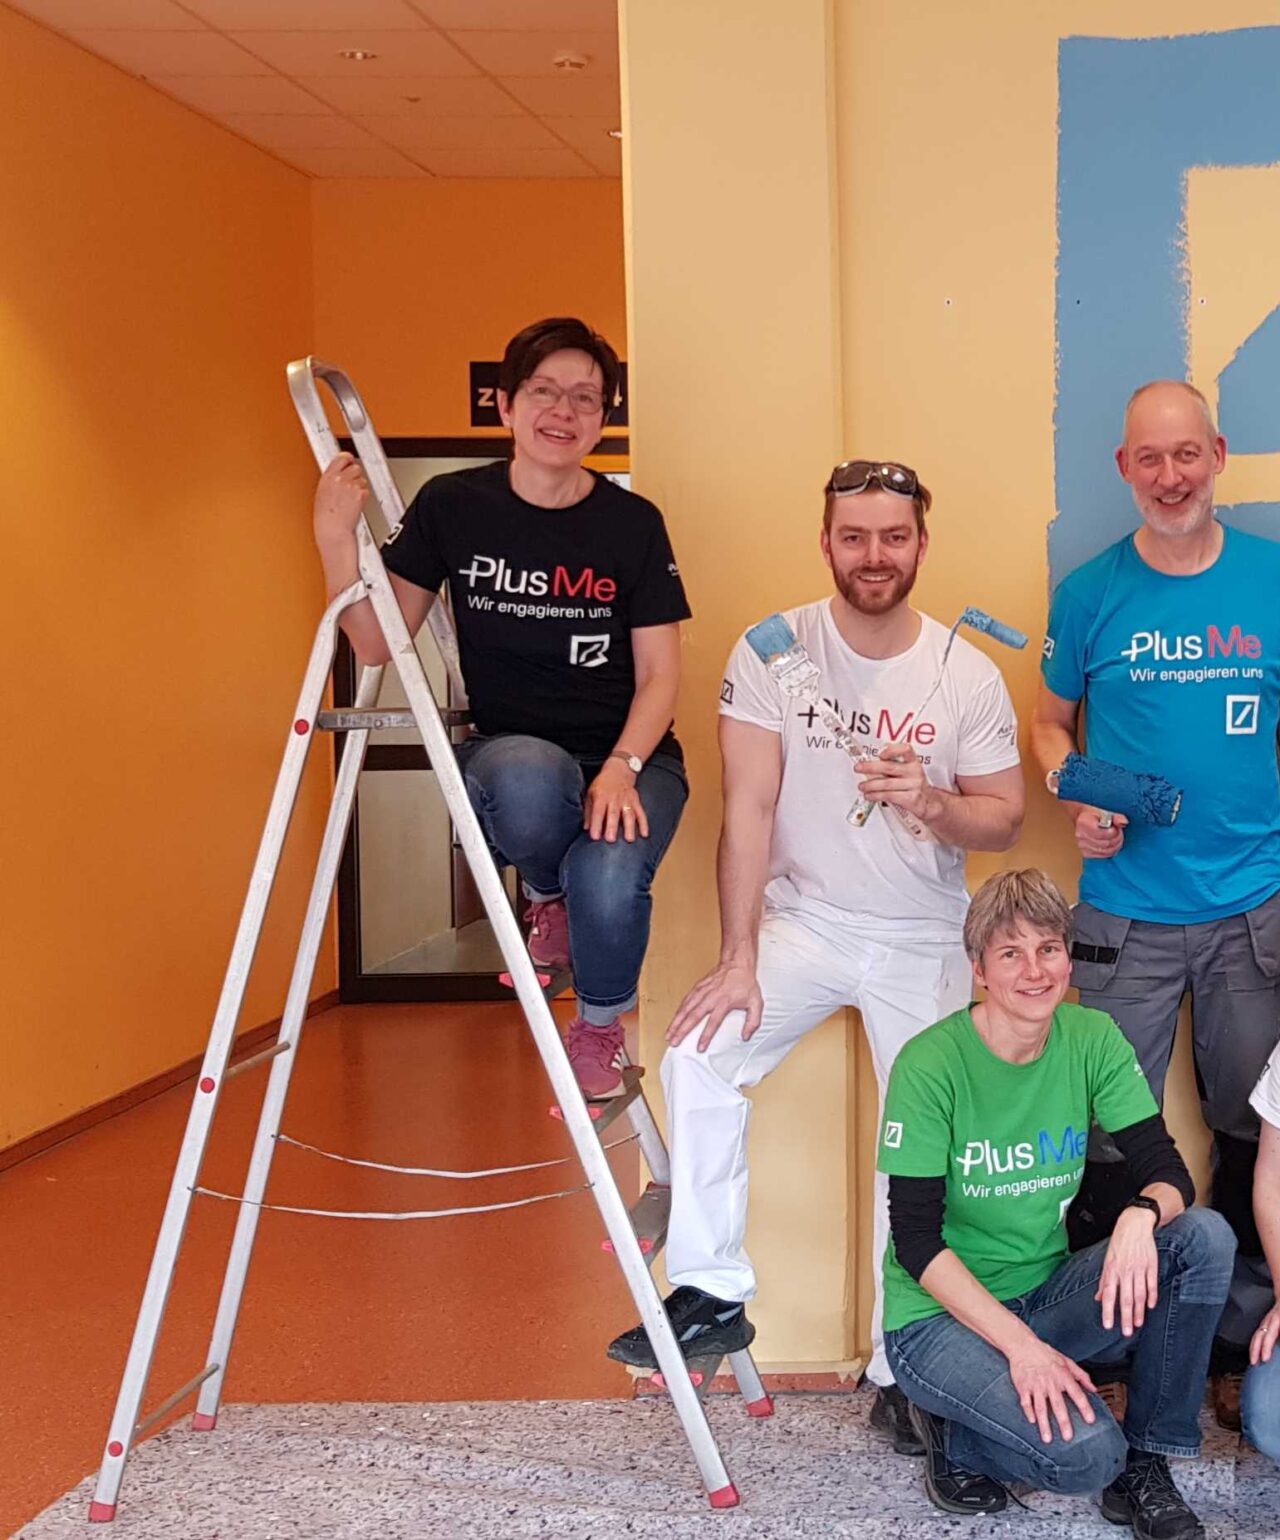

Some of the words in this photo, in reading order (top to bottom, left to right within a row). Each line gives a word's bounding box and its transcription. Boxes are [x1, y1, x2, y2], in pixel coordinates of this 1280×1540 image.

[553, 565, 617, 602] Me
[468, 594, 495, 611] Wir
[497, 601, 584, 619] engagieren
[588, 606, 612, 618] uns
[1206, 624, 1262, 659] Me
[1130, 668, 1156, 682] Wir
[1160, 666, 1238, 683] engagieren
[1242, 667, 1263, 679] uns
[806, 735, 832, 749] Wir
[962, 1183, 991, 1198] Wir
[994, 1174, 1071, 1196] engagieren
